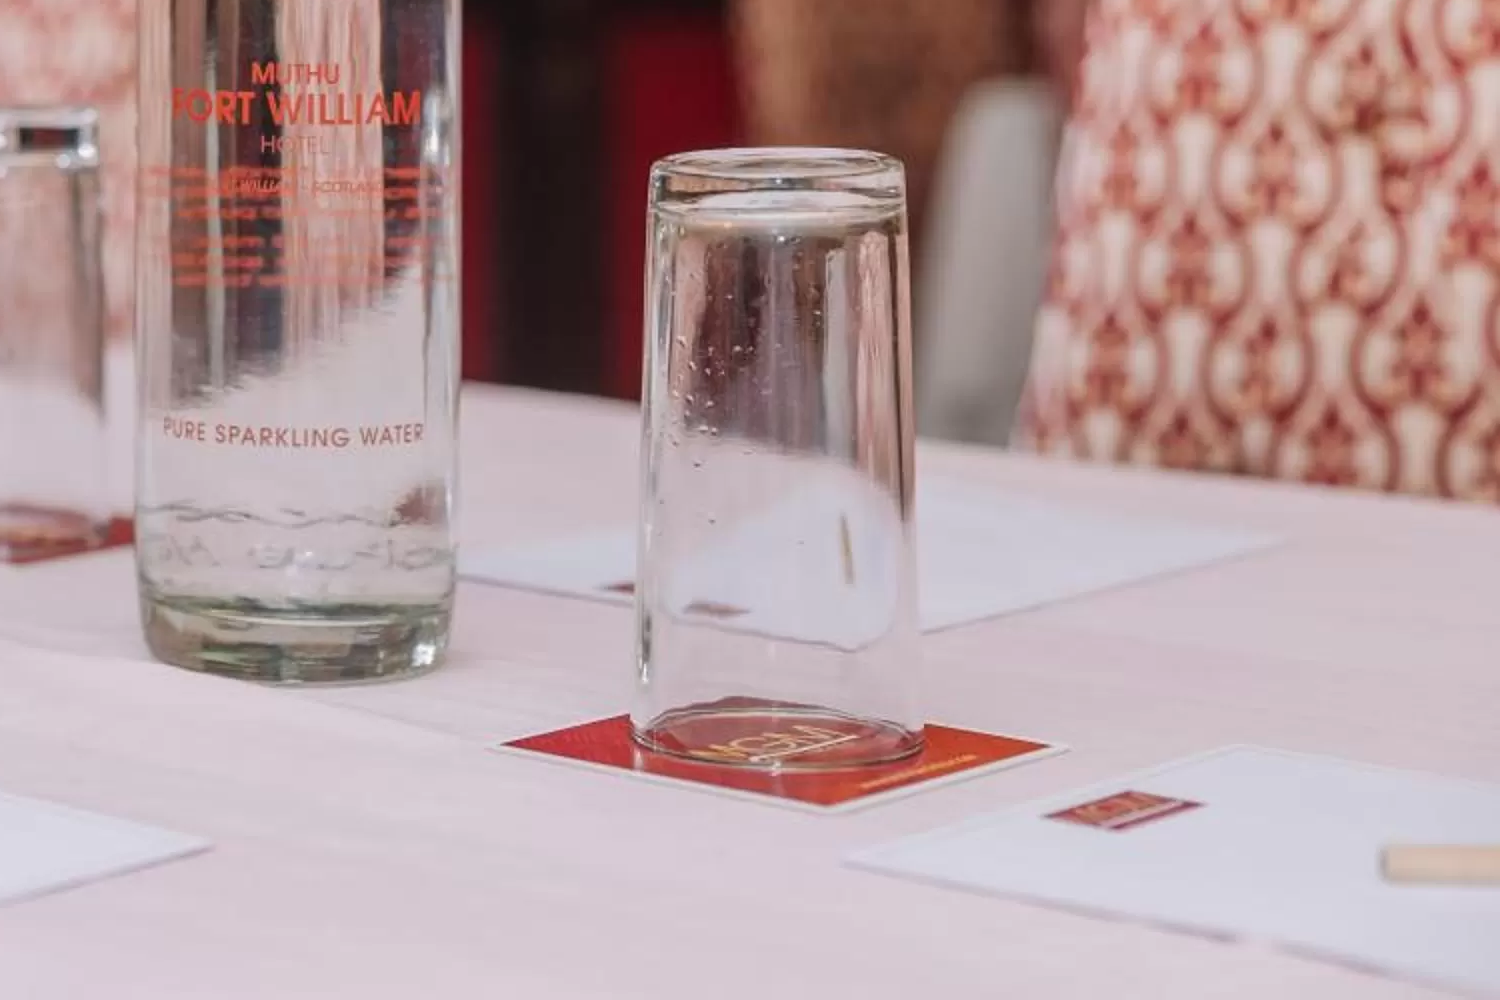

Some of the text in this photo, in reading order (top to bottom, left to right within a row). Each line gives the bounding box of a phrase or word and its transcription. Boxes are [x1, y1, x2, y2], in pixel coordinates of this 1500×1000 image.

[251, 62, 340, 86] MUTHU
[171, 87, 421, 125] FORT WILLIAM
[261, 135, 331, 153] HOTEL
[163, 416, 424, 447] PURE SPARKLING WATER
